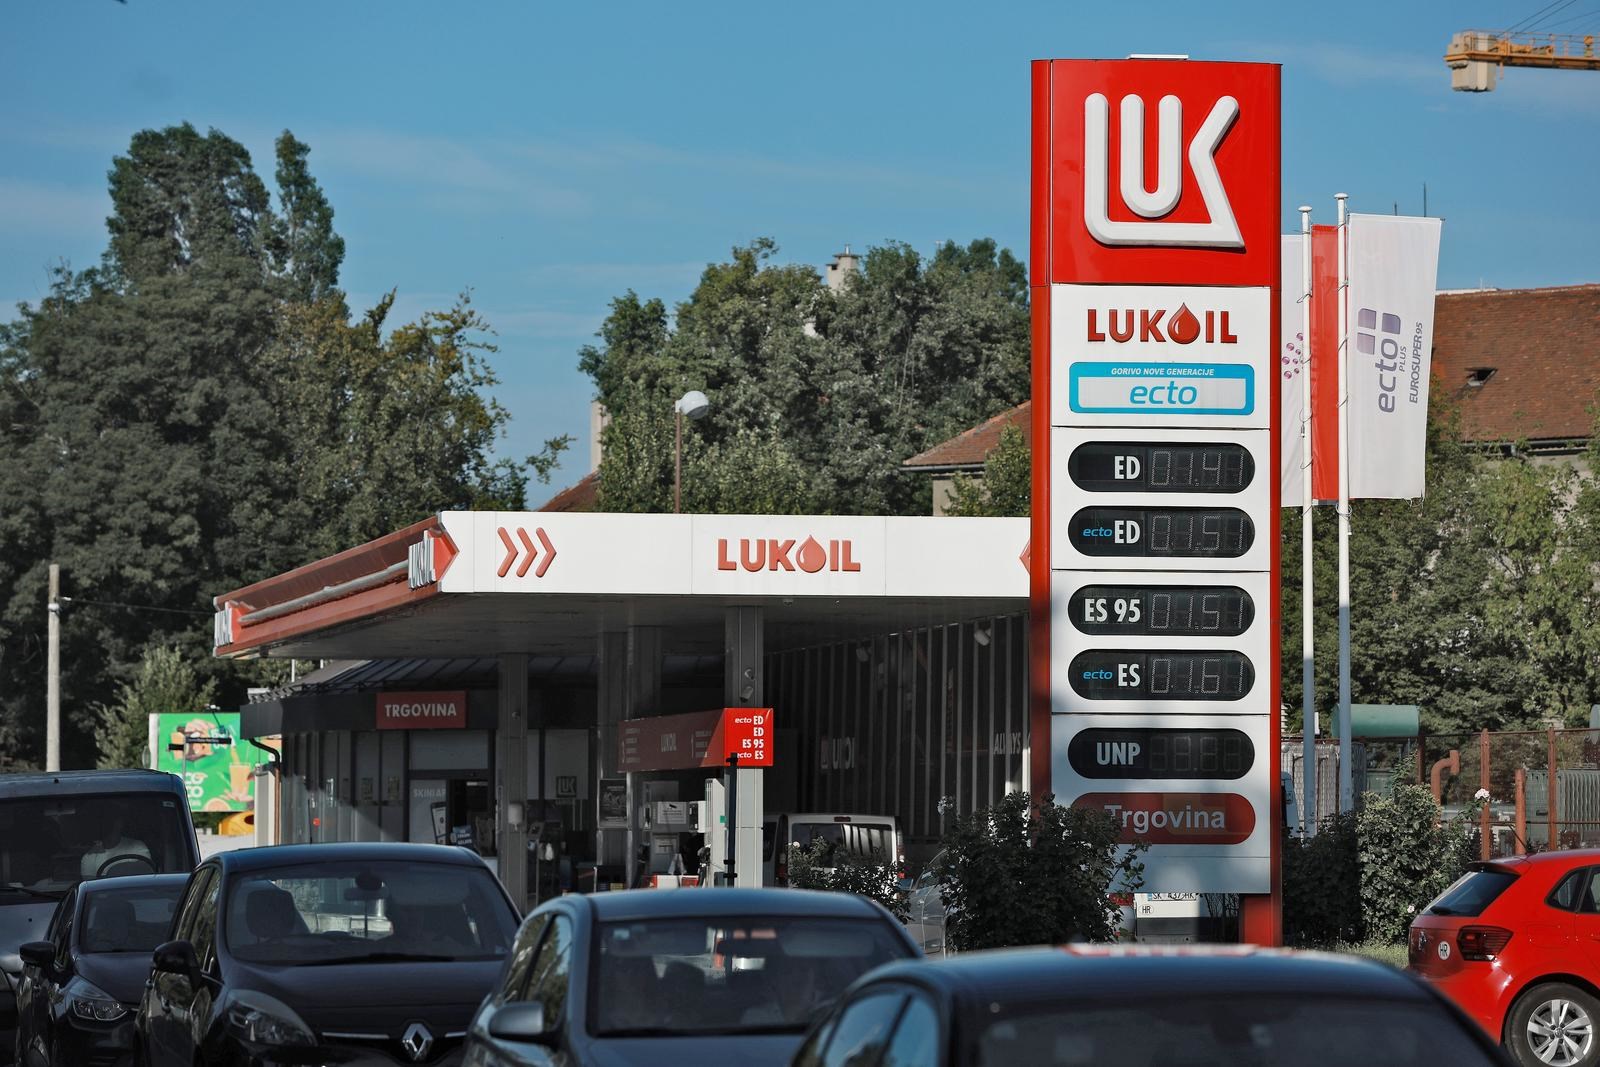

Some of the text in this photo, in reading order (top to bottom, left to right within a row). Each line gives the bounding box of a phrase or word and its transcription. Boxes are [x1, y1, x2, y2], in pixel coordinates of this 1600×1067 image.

[1087, 302, 1238, 344] LUKOIL
[1399, 345, 1407, 372] PLUS
[1111, 367, 1215, 376] GORIVO NOVE GENERACIJE
[1375, 338, 1399, 413] ecto
[1129, 380, 1198, 405] ecto
[1114, 456, 1141, 479] ED
[1083, 526, 1112, 537] ecto
[1114, 520, 1141, 544] ED
[717, 535, 862, 573] LUKOIL
[1084, 598, 1108, 622] ES
[1114, 598, 1141, 622] 95
[1083, 669, 1113, 680] ecto
[1118, 663, 1141, 687] ES
[384, 703, 457, 719] TRGOVINA
[753, 715, 764, 725] ED
[753, 727, 764, 736] ED
[742, 739, 764, 748] ES 95
[754, 750, 764, 760] ES
[1096, 742, 1140, 765] UNP
[1104, 804, 1225, 834] Trgovina
[1142, 906, 1151, 914] HR
